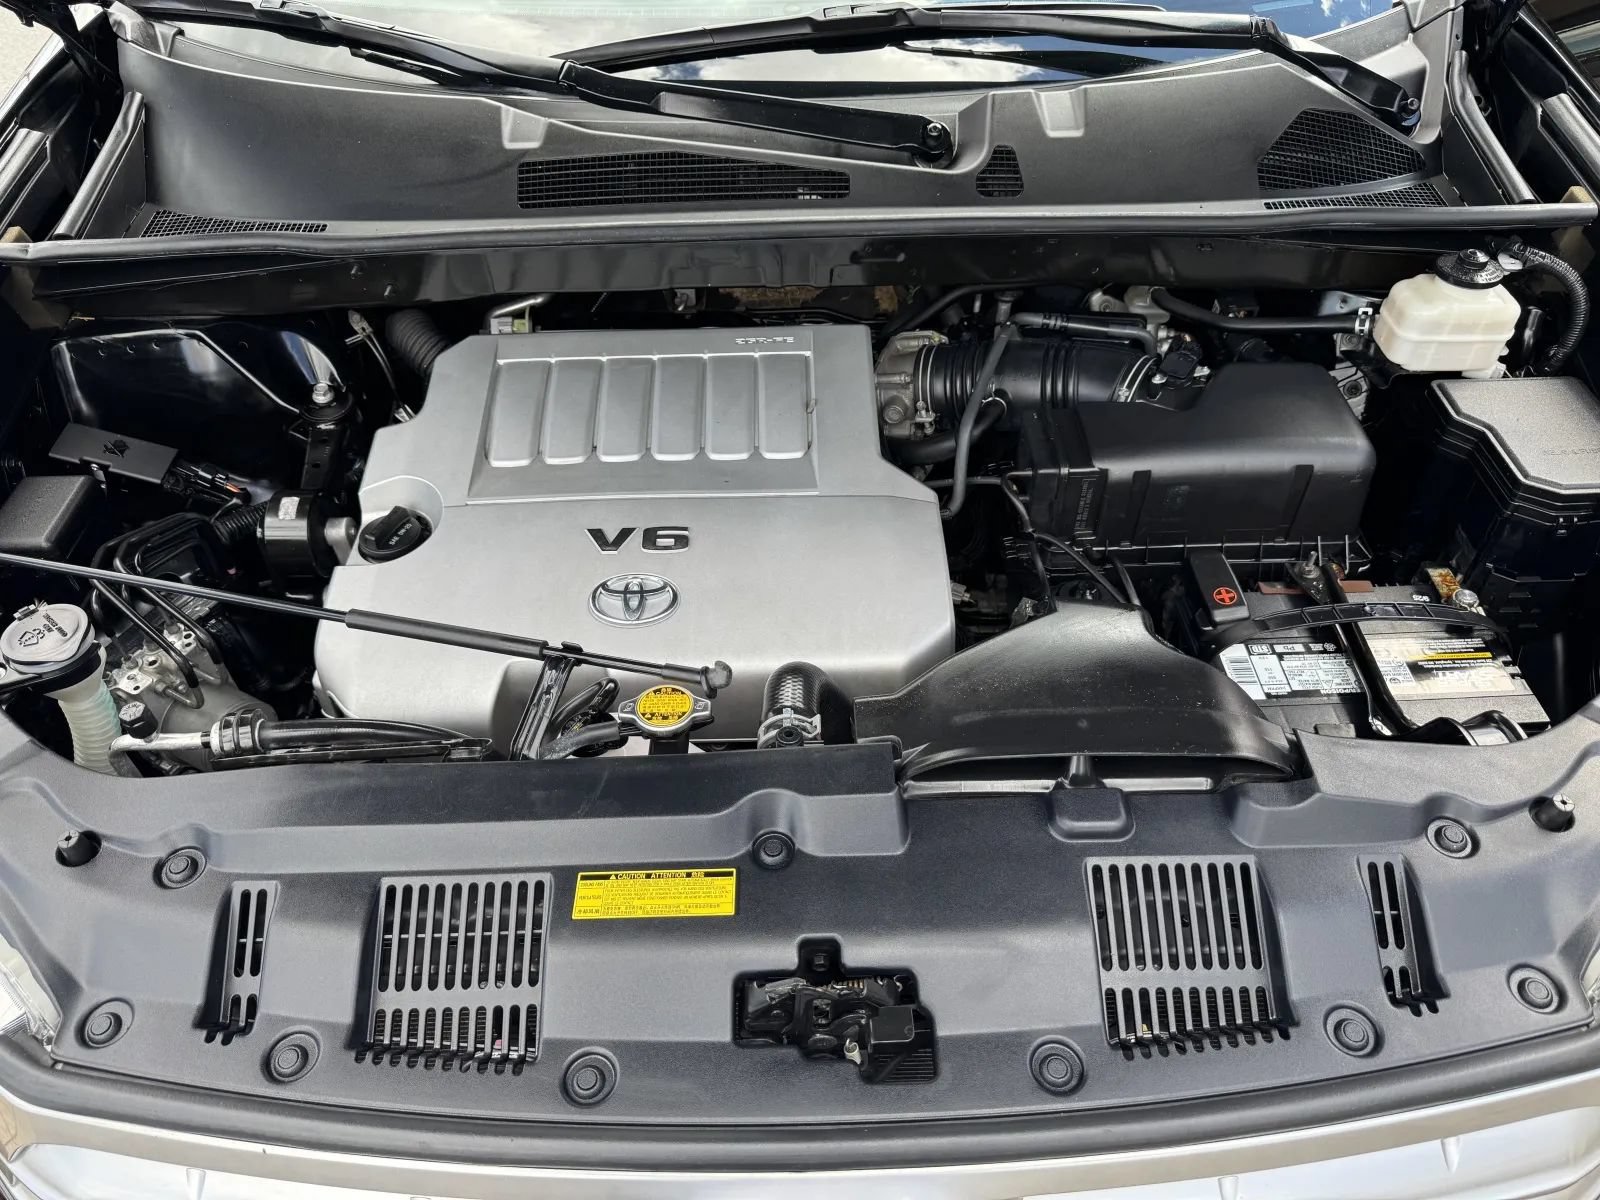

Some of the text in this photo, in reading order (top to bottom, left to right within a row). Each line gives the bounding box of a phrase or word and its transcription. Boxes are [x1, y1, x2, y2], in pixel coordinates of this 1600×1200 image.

[584, 526, 689, 554] V6
[617, 872, 646, 880] CAUTION
[650, 871, 687, 879] ATTENTION
